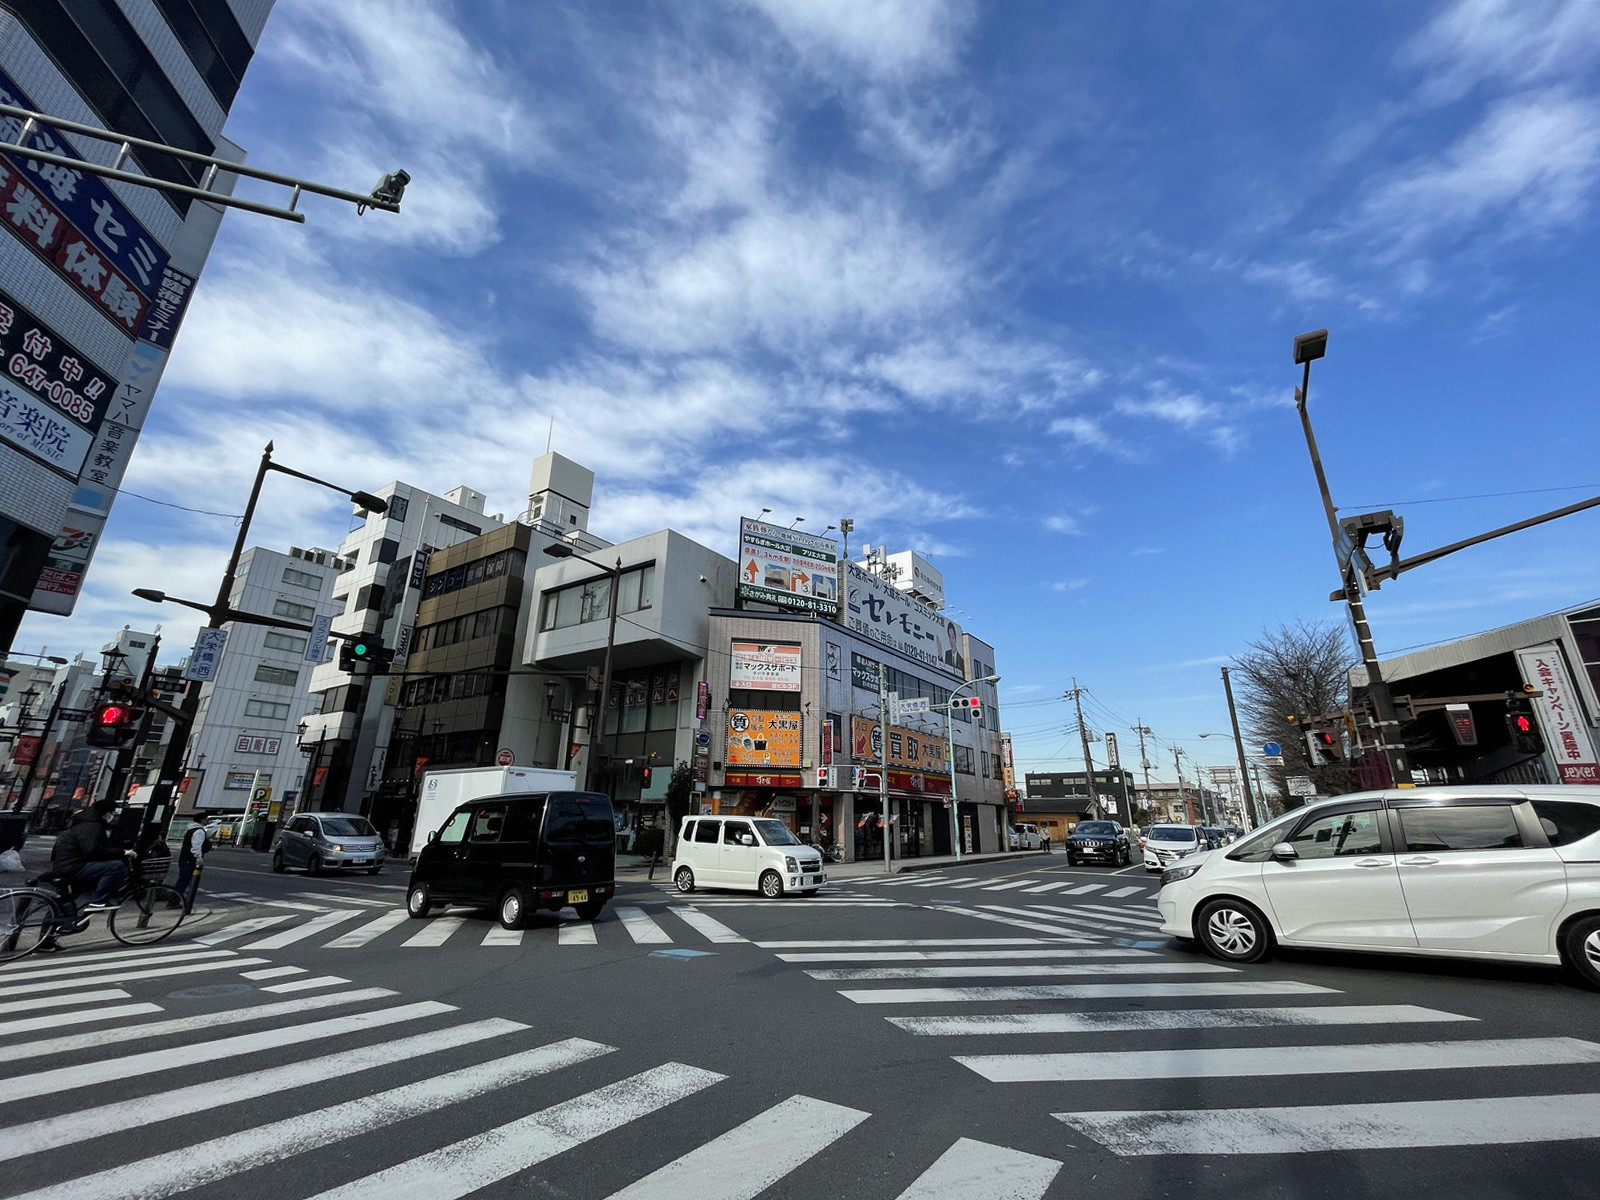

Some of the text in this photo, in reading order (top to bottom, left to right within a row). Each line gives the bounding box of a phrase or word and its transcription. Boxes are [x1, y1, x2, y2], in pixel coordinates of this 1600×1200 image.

[30, 435, 67, 462] MUSIC
[862, 592, 935, 642] セレモニー
[743, 662, 797, 673] マックスサポート
[732, 714, 748, 730] 質
[767, 719, 799, 731] 大黒屋
